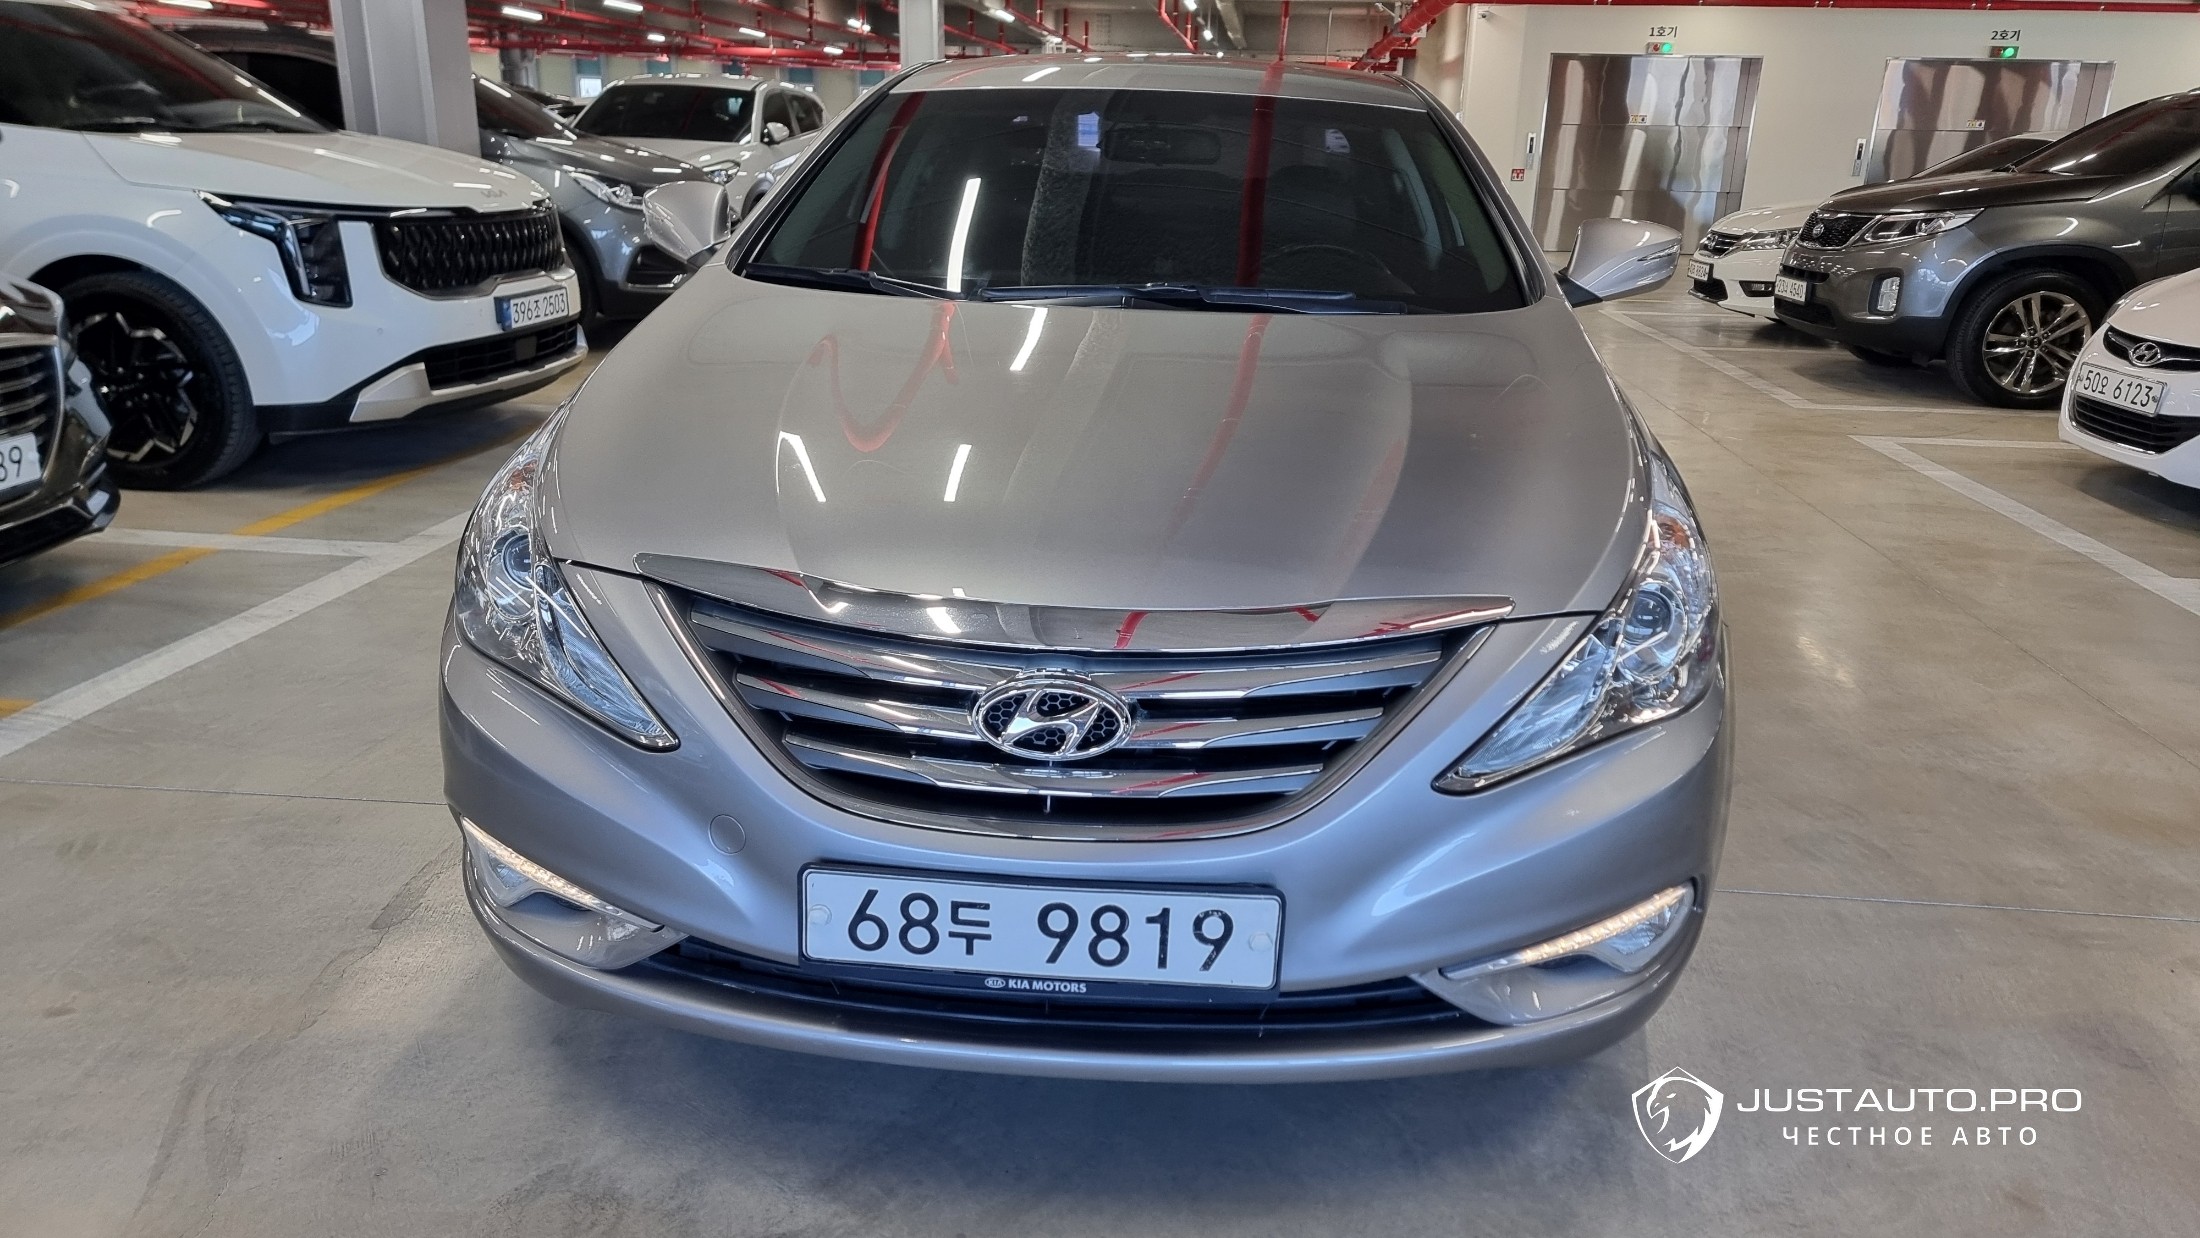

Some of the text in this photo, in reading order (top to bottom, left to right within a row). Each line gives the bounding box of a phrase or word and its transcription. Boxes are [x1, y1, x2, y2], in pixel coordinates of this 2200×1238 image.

[1649, 26, 1678, 38] 1호기
[1990, 30, 2021, 41] 2호기
[512, 293, 566, 324] 396조 2503
[2083, 369, 2153, 408] 50오 6123
[847, 889, 1234, 972] 68두 9819
[1008, 979, 1030, 989] KIA
[1031, 981, 1087, 993] MOTORS
